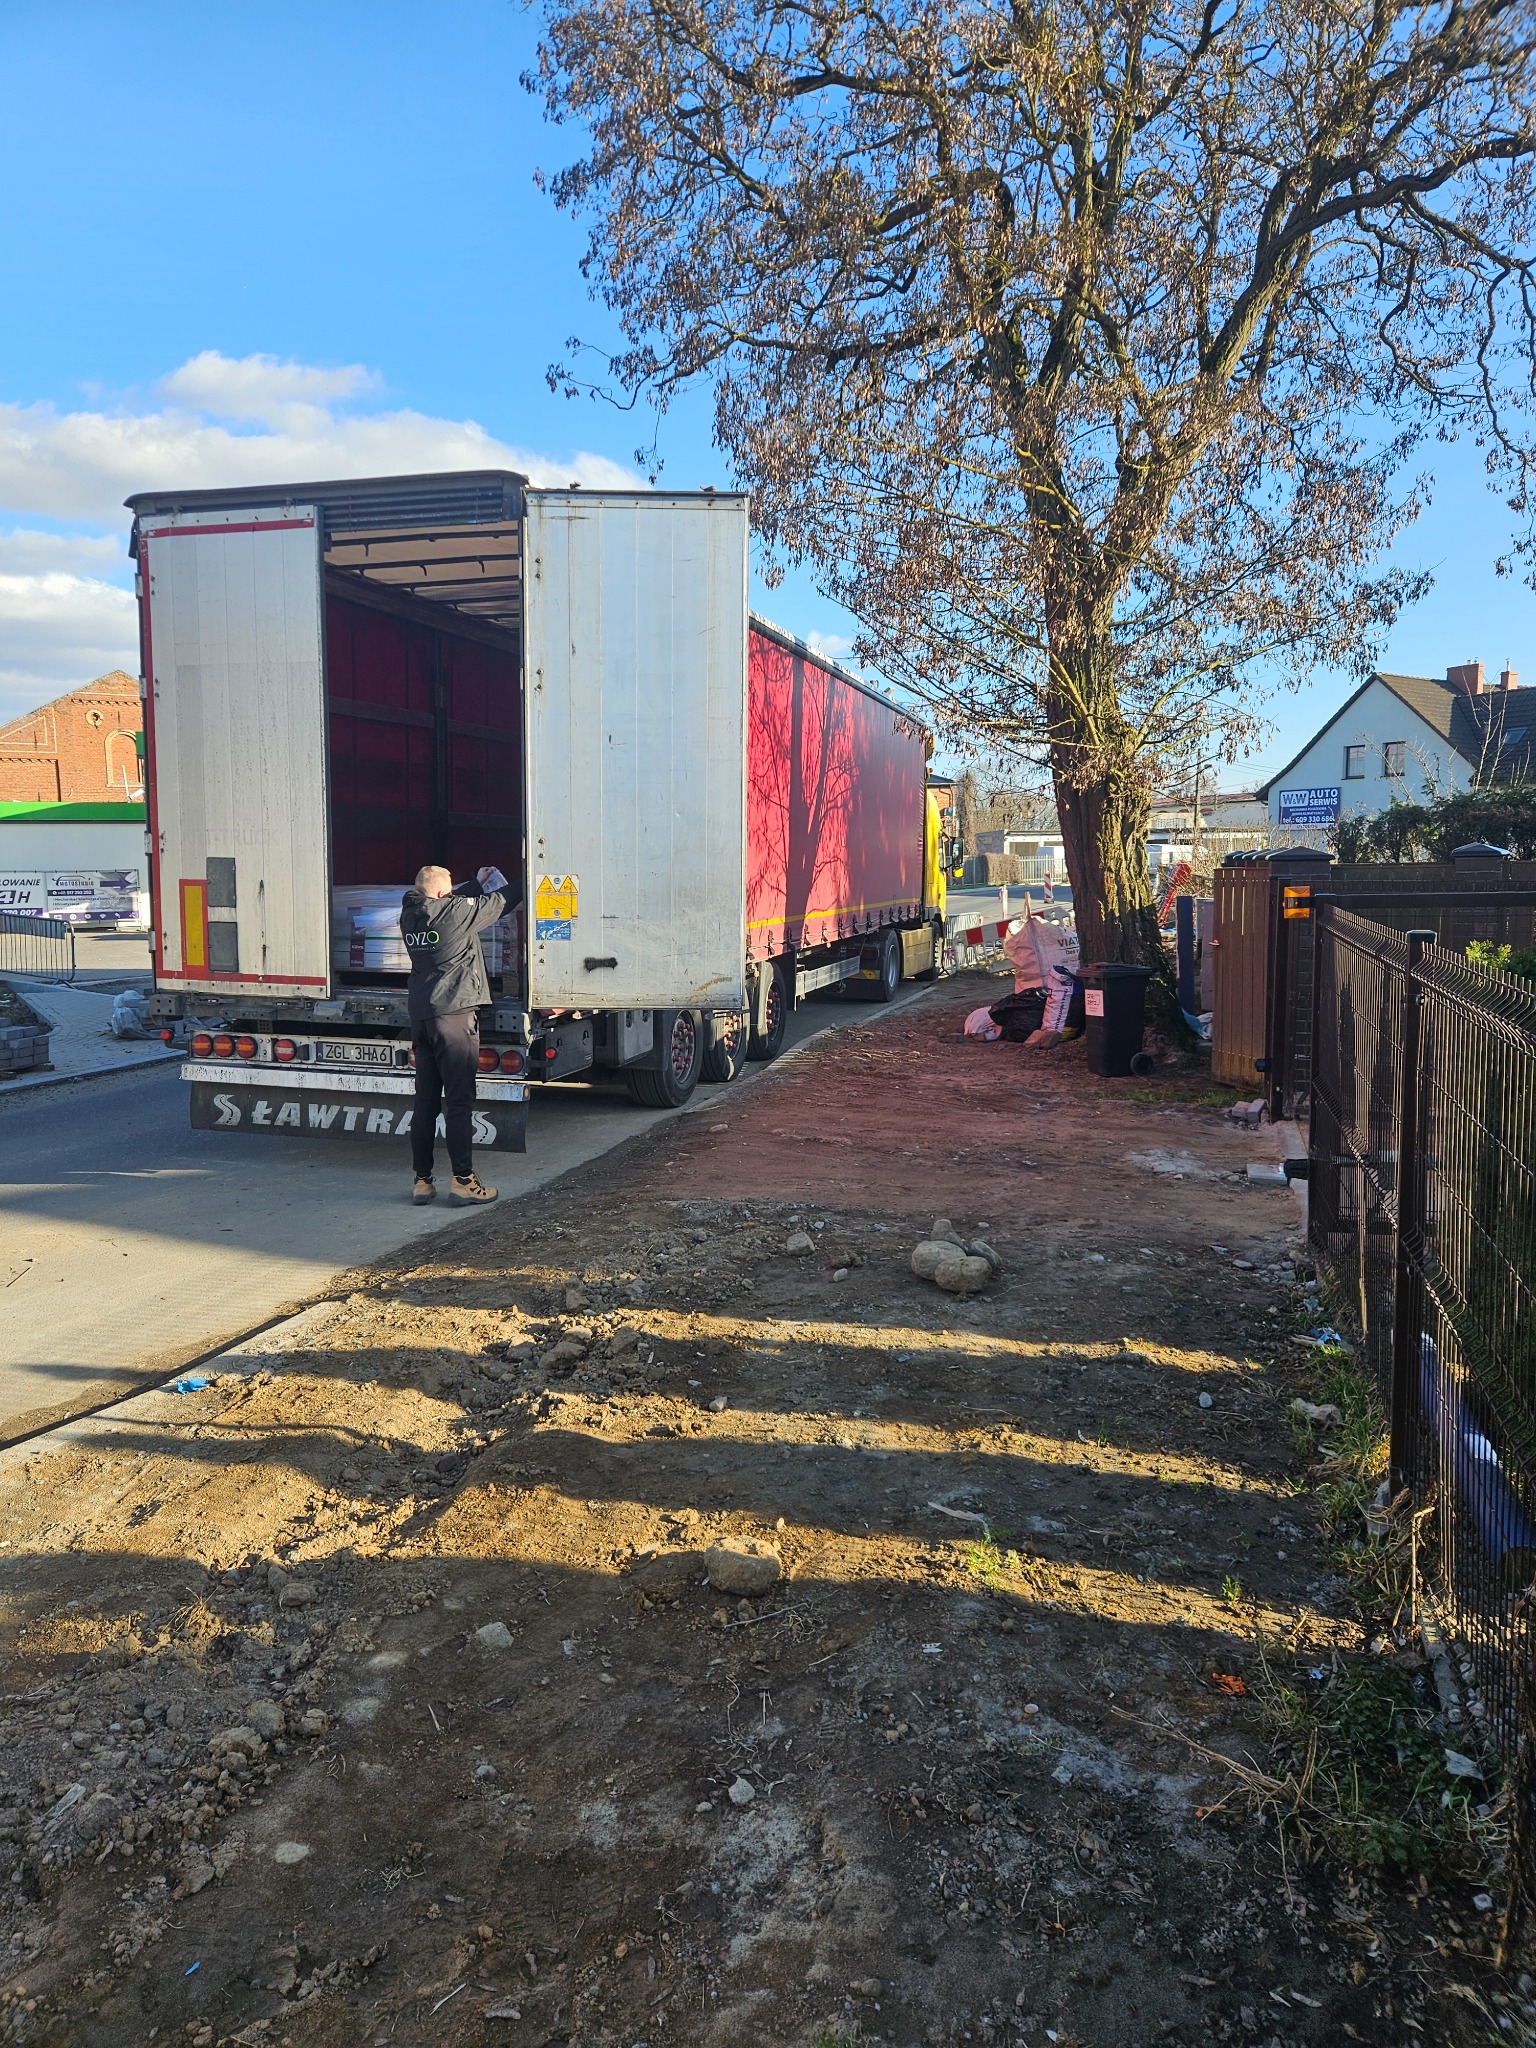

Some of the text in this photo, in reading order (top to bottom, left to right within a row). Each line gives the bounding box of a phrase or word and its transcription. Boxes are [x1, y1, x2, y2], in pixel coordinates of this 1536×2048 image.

[1283, 793, 1306, 804] W&W
[1310, 789, 1338, 798] AUTO
[1310, 798, 1338, 806] SERWIS
[0, 879, 41, 887] OWANIE
[405, 930, 440, 946] OYZO
[325, 1044, 387, 1062] ZGL 3HA6
